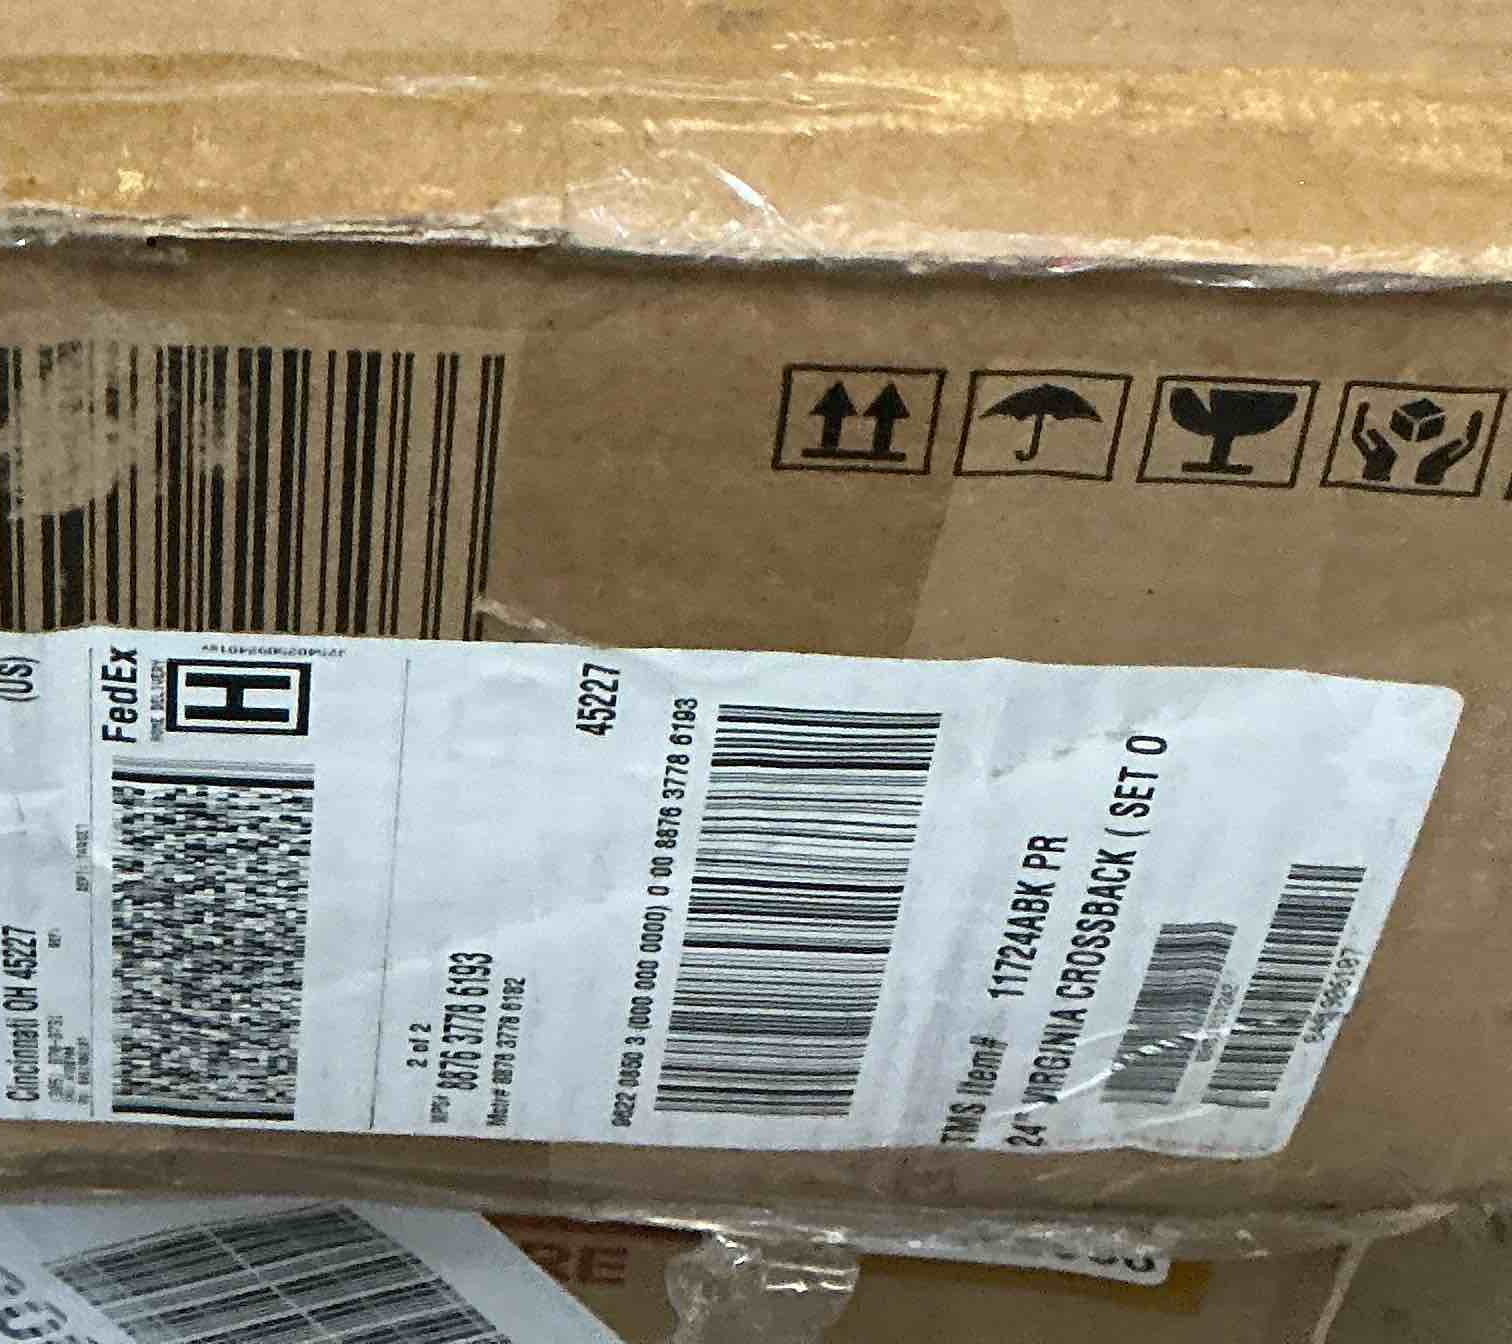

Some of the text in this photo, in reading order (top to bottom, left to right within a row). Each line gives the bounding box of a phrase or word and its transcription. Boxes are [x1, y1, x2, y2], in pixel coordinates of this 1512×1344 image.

[100, 644, 139, 744] FedEx
[575, 663, 620, 738] 45227
[668, 698, 699, 747] 6193
[661, 754, 690, 800] 3778
[1108, 765, 1160, 819] SET
[654, 806, 683, 849] 8876
[1103, 827, 1150, 838] (
[650, 856, 674, 878] 00
[648, 885, 671, 897] 0
[639, 905, 672, 954] 0000)
[1054, 850, 1139, 1000] CROSSBACK
[445, 952, 493, 997] 6193
[635, 960, 659, 991] 000
[939, 835, 1069, 1145] TMS Item# 11724ABK PR
[1, 924, 40, 1102] Cincinnati OH 45227
[440, 1003, 487, 1045] 3778
[495, 1016, 521, 1049] 3778
[627, 996, 655, 1031] (000
[405, 1023, 432, 1069] 2 of 2
[624, 1036, 646, 1046] 3
[1020, 1008, 1089, 1106] VIRGINIA
[435, 1050, 482, 1091] 8876
